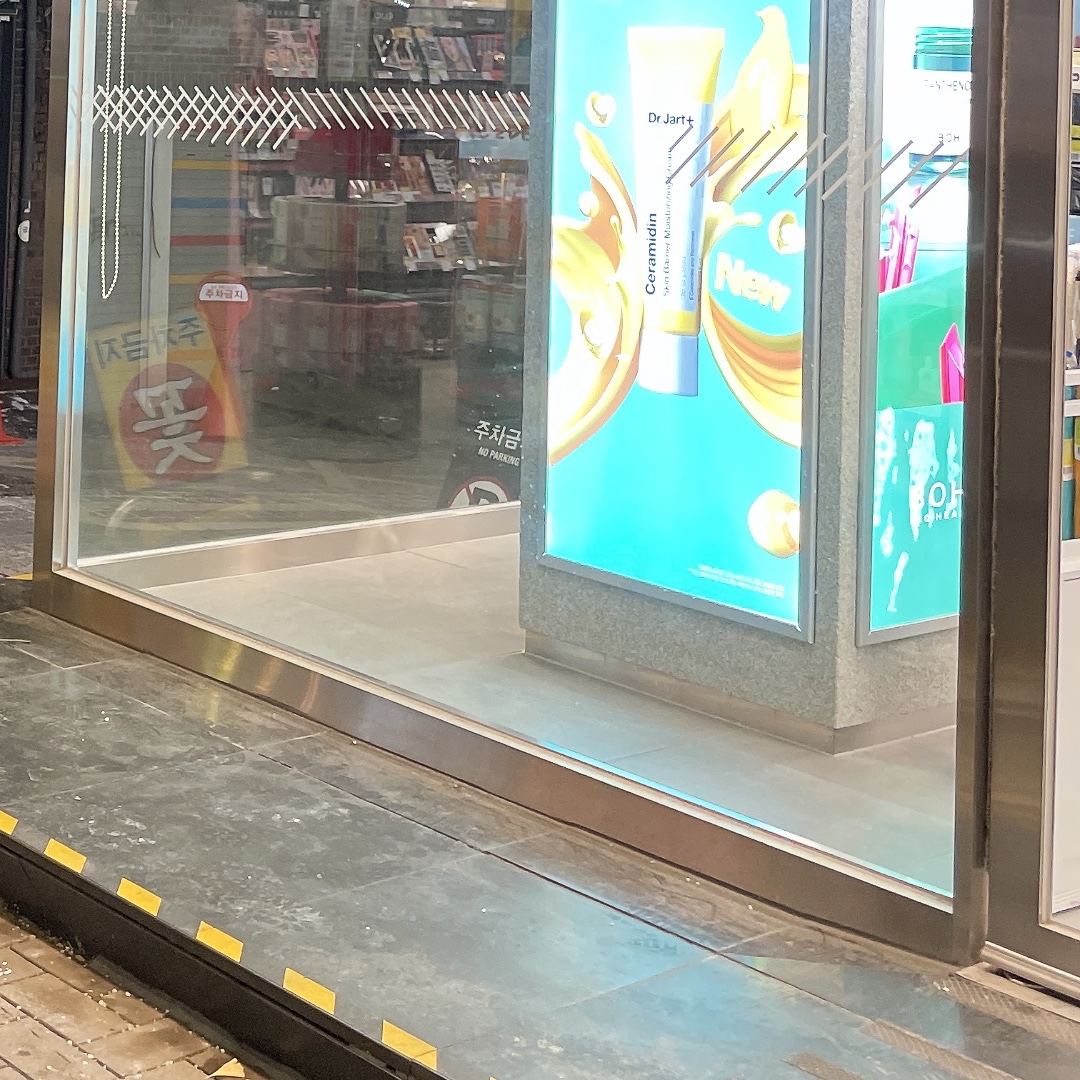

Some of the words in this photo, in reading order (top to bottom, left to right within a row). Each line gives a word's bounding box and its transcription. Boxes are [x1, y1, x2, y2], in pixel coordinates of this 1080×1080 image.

[645, 212, 657, 295] Ceramidin
[206, 289, 243, 299] 주차금지
[477, 446, 489, 457] NO
[489, 450, 521, 467] PARKING
